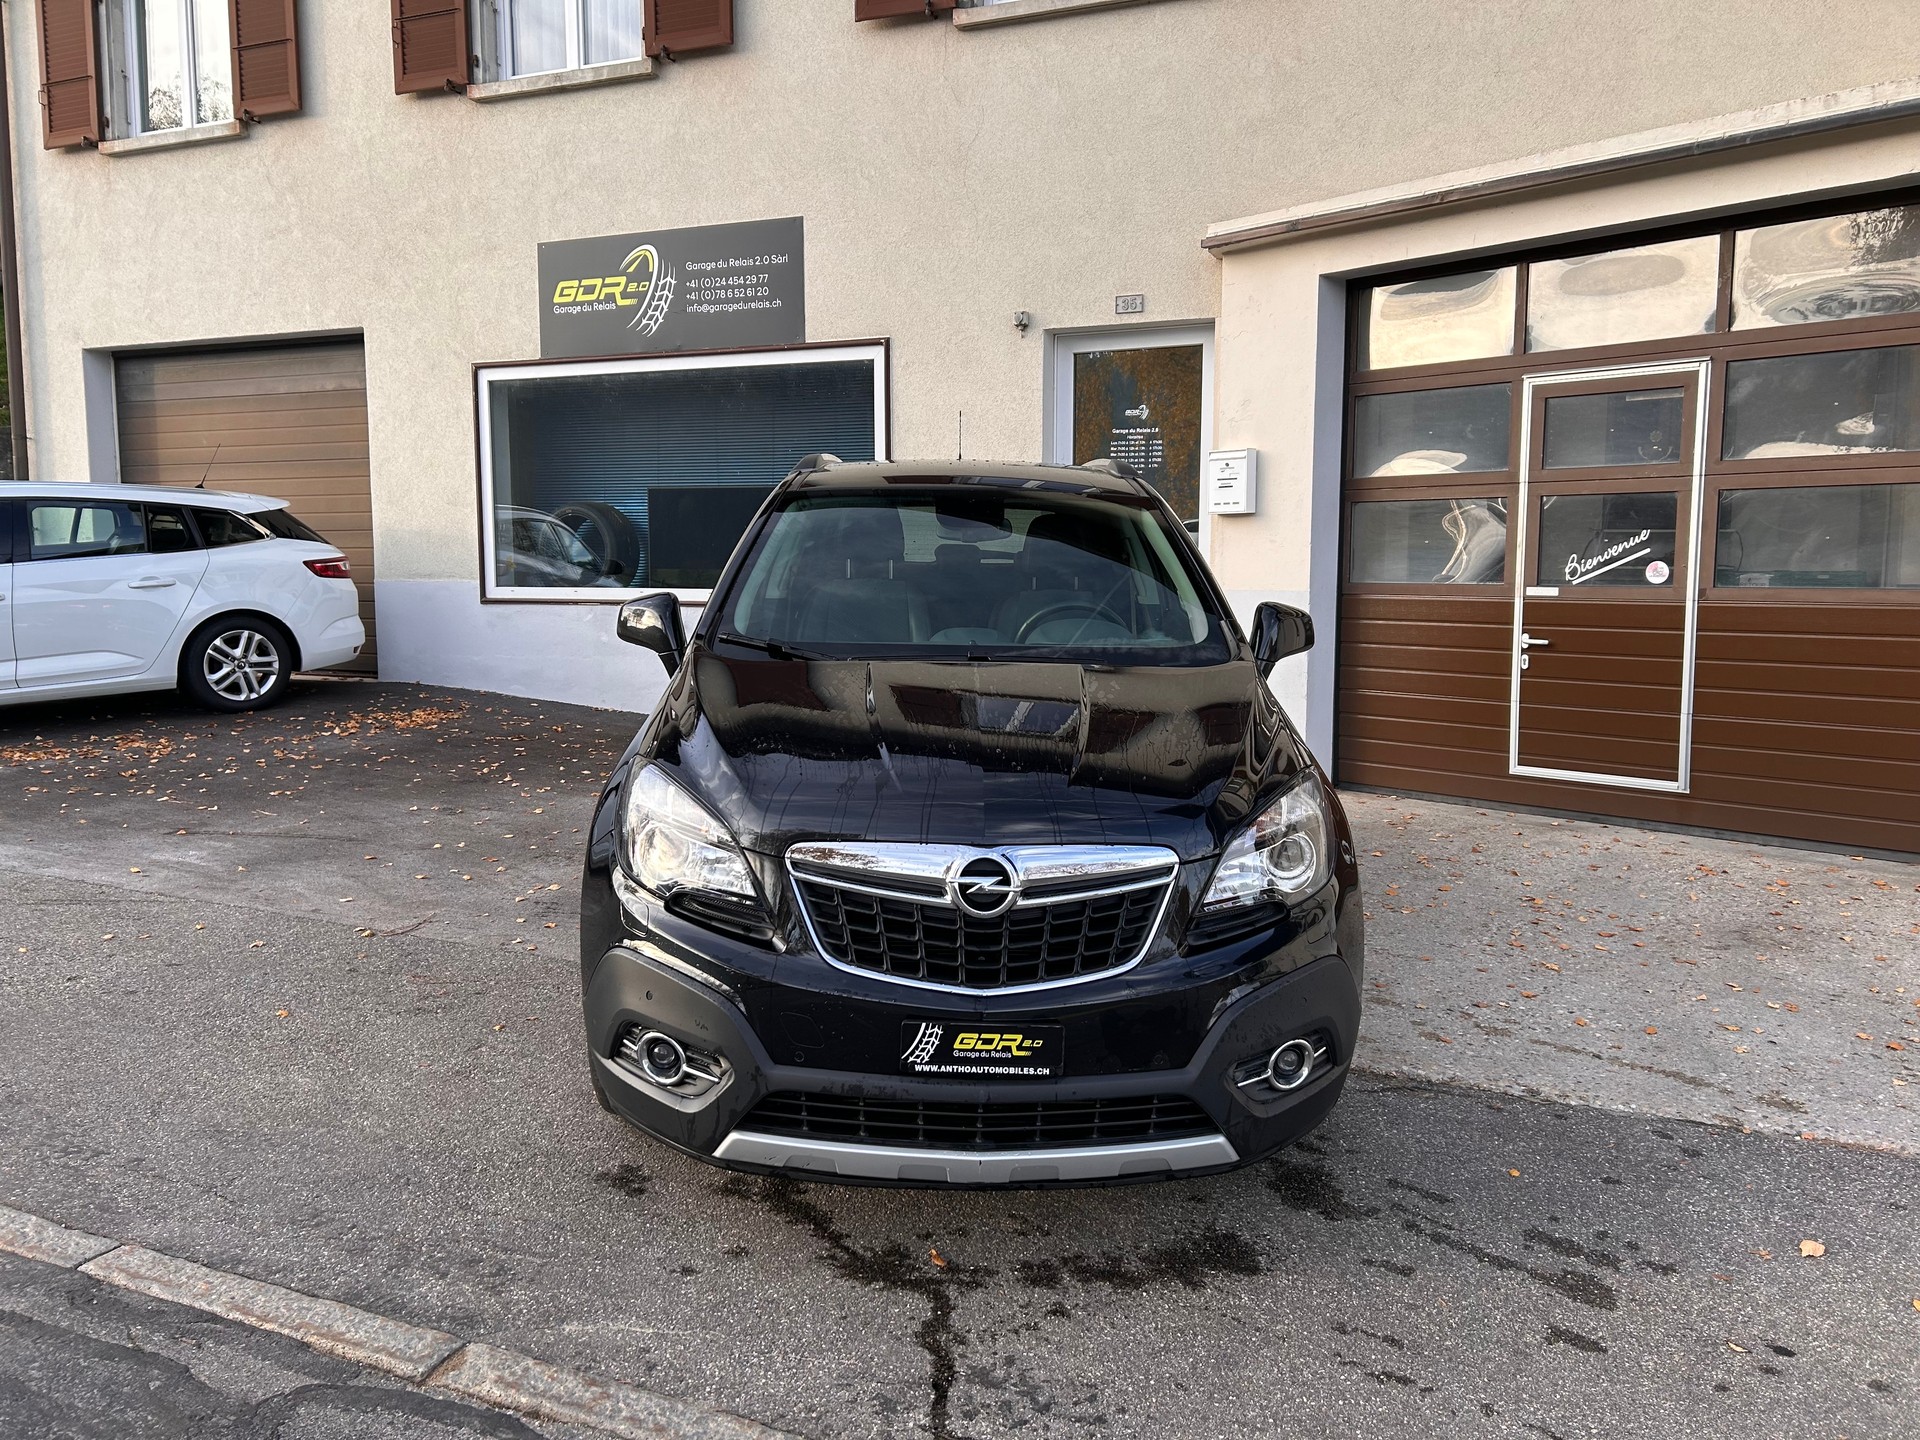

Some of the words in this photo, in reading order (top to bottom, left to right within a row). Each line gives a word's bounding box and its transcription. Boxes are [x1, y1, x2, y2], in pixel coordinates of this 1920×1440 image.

[686, 262, 716, 270] Garage
[717, 259, 727, 268] du
[729, 257, 753, 267] Relais
[755, 255, 769, 265] 2.0
[771, 254, 788, 263] Sàrl
[686, 280, 698, 288] +41
[701, 277, 726, 288] (0)24
[728, 276, 744, 285] 454
[745, 275, 756, 284] 29
[758, 274, 768, 283] 77
[553, 276, 633, 305] GDR
[627, 282, 649, 292] 2.0
[686, 292, 698, 300] +41
[701, 289, 726, 300] (0)78
[746, 288, 755, 297] 61
[757, 287, 769, 296] 20
[553, 305, 581, 314] Garage
[582, 303, 592, 311] du
[593, 302, 616, 311] Relais
[686, 298, 782, 313] info@garagedurelais.ch
[1121, 297, 1137, 311] 35
[1565, 529, 1651, 581] Bienvenue
[953, 1033, 1026, 1056] GDR
[1022, 1039, 1043, 1047] 2.0
[953, 1050, 979, 1058] Garage
[980, 1050, 990, 1058] du
[914, 1064, 1050, 1075] WWW.ANTHOAUTOMOBILES.CH
